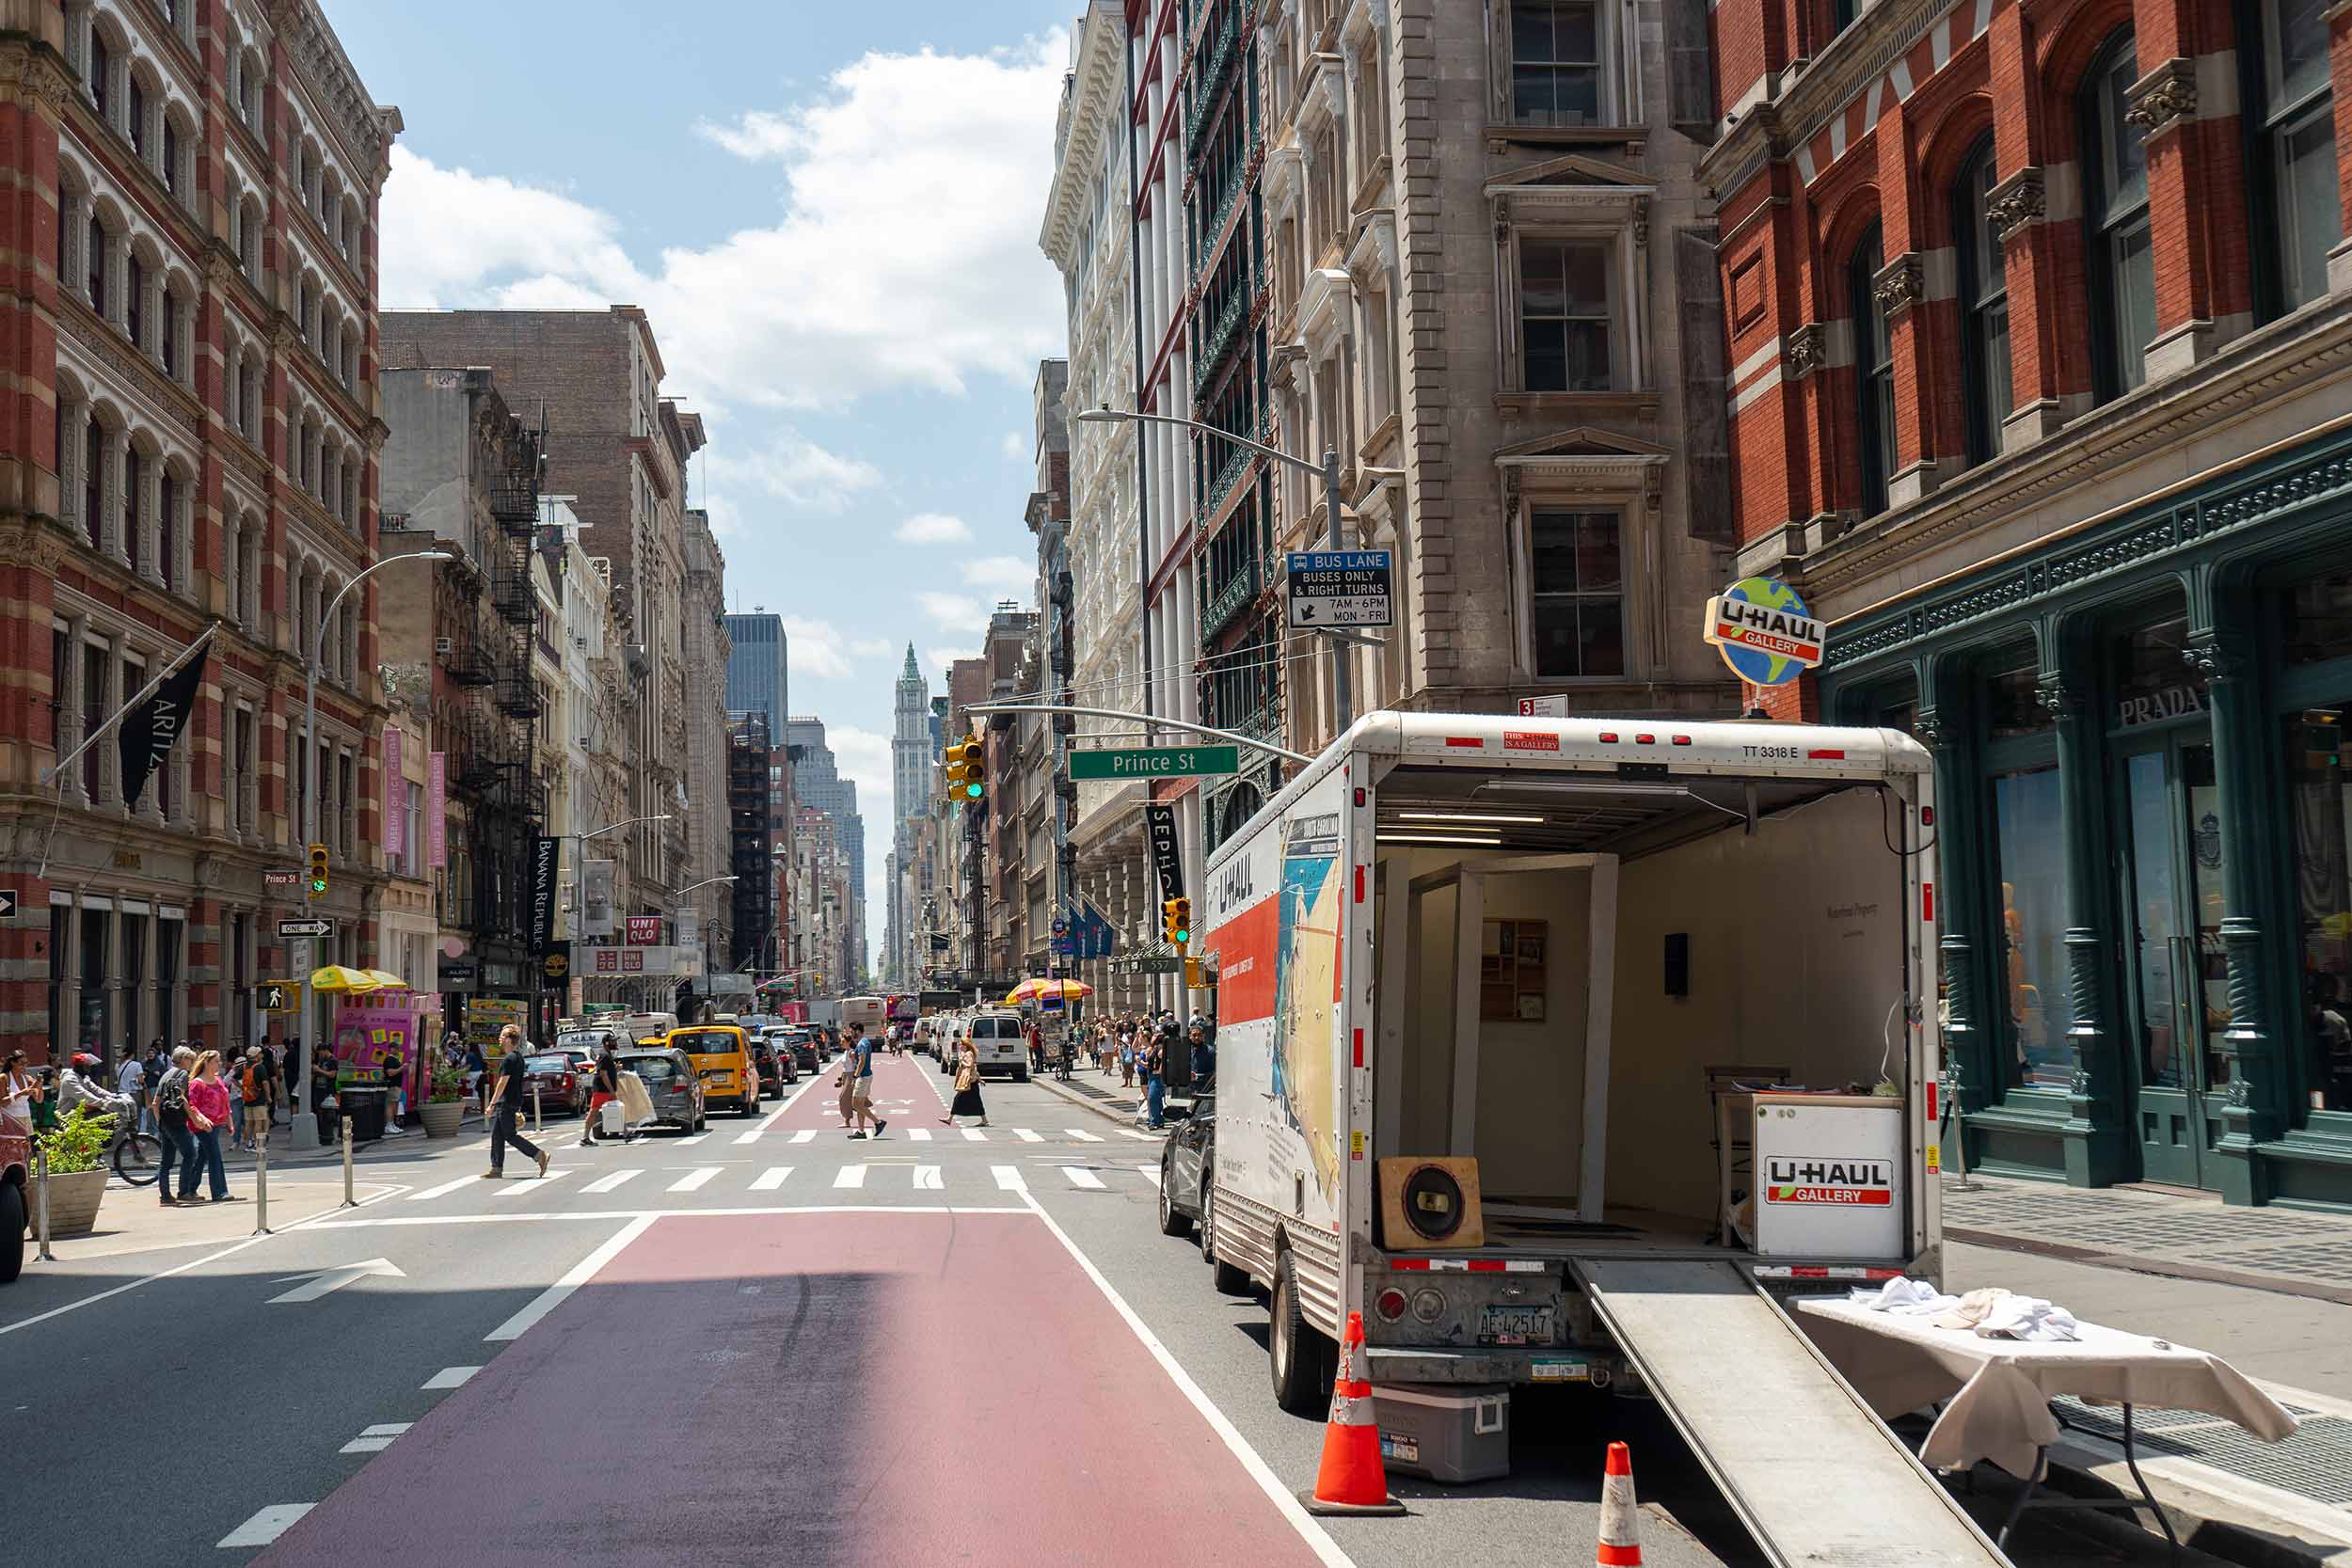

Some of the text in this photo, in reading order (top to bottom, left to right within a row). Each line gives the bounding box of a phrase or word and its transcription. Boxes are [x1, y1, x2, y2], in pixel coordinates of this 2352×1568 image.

[1314, 554, 1384, 568] BUS LANE
[1302, 570, 1375, 583] BUSES ONLY
[1295, 583, 1385, 596] & RIGHT TURNS
[1329, 598, 1353, 609] 7AM
[1361, 598, 1385, 609] 6PM
[1333, 611, 1357, 622] MON
[1369, 610, 1386, 621] FRI
[1722, 600, 1820, 643] U-HAUL
[1745, 631, 1799, 654] GALLERY
[1522, 701, 1532, 716] 3
[2122, 686, 2201, 725] PRADA
[1520, 740, 1558, 750] GALLERY
[1742, 745, 1799, 758] TT 3318 E
[1113, 752, 1196, 773] Prince St
[1153, 811, 1175, 900] SEPHO
[265, 874, 296, 884] Prince St
[1219, 851, 1253, 915] U-HAUL
[532, 841, 551, 950] BANANA REPUBLIC
[285, 925, 326, 933] ONE WAY
[631, 919, 655, 929] UNI
[630, 929, 655, 942] QLO
[1151, 959, 1169, 970] 557
[1771, 1162, 1888, 1185] U-HAUL
[1795, 1188, 1862, 1202] GALLERY
